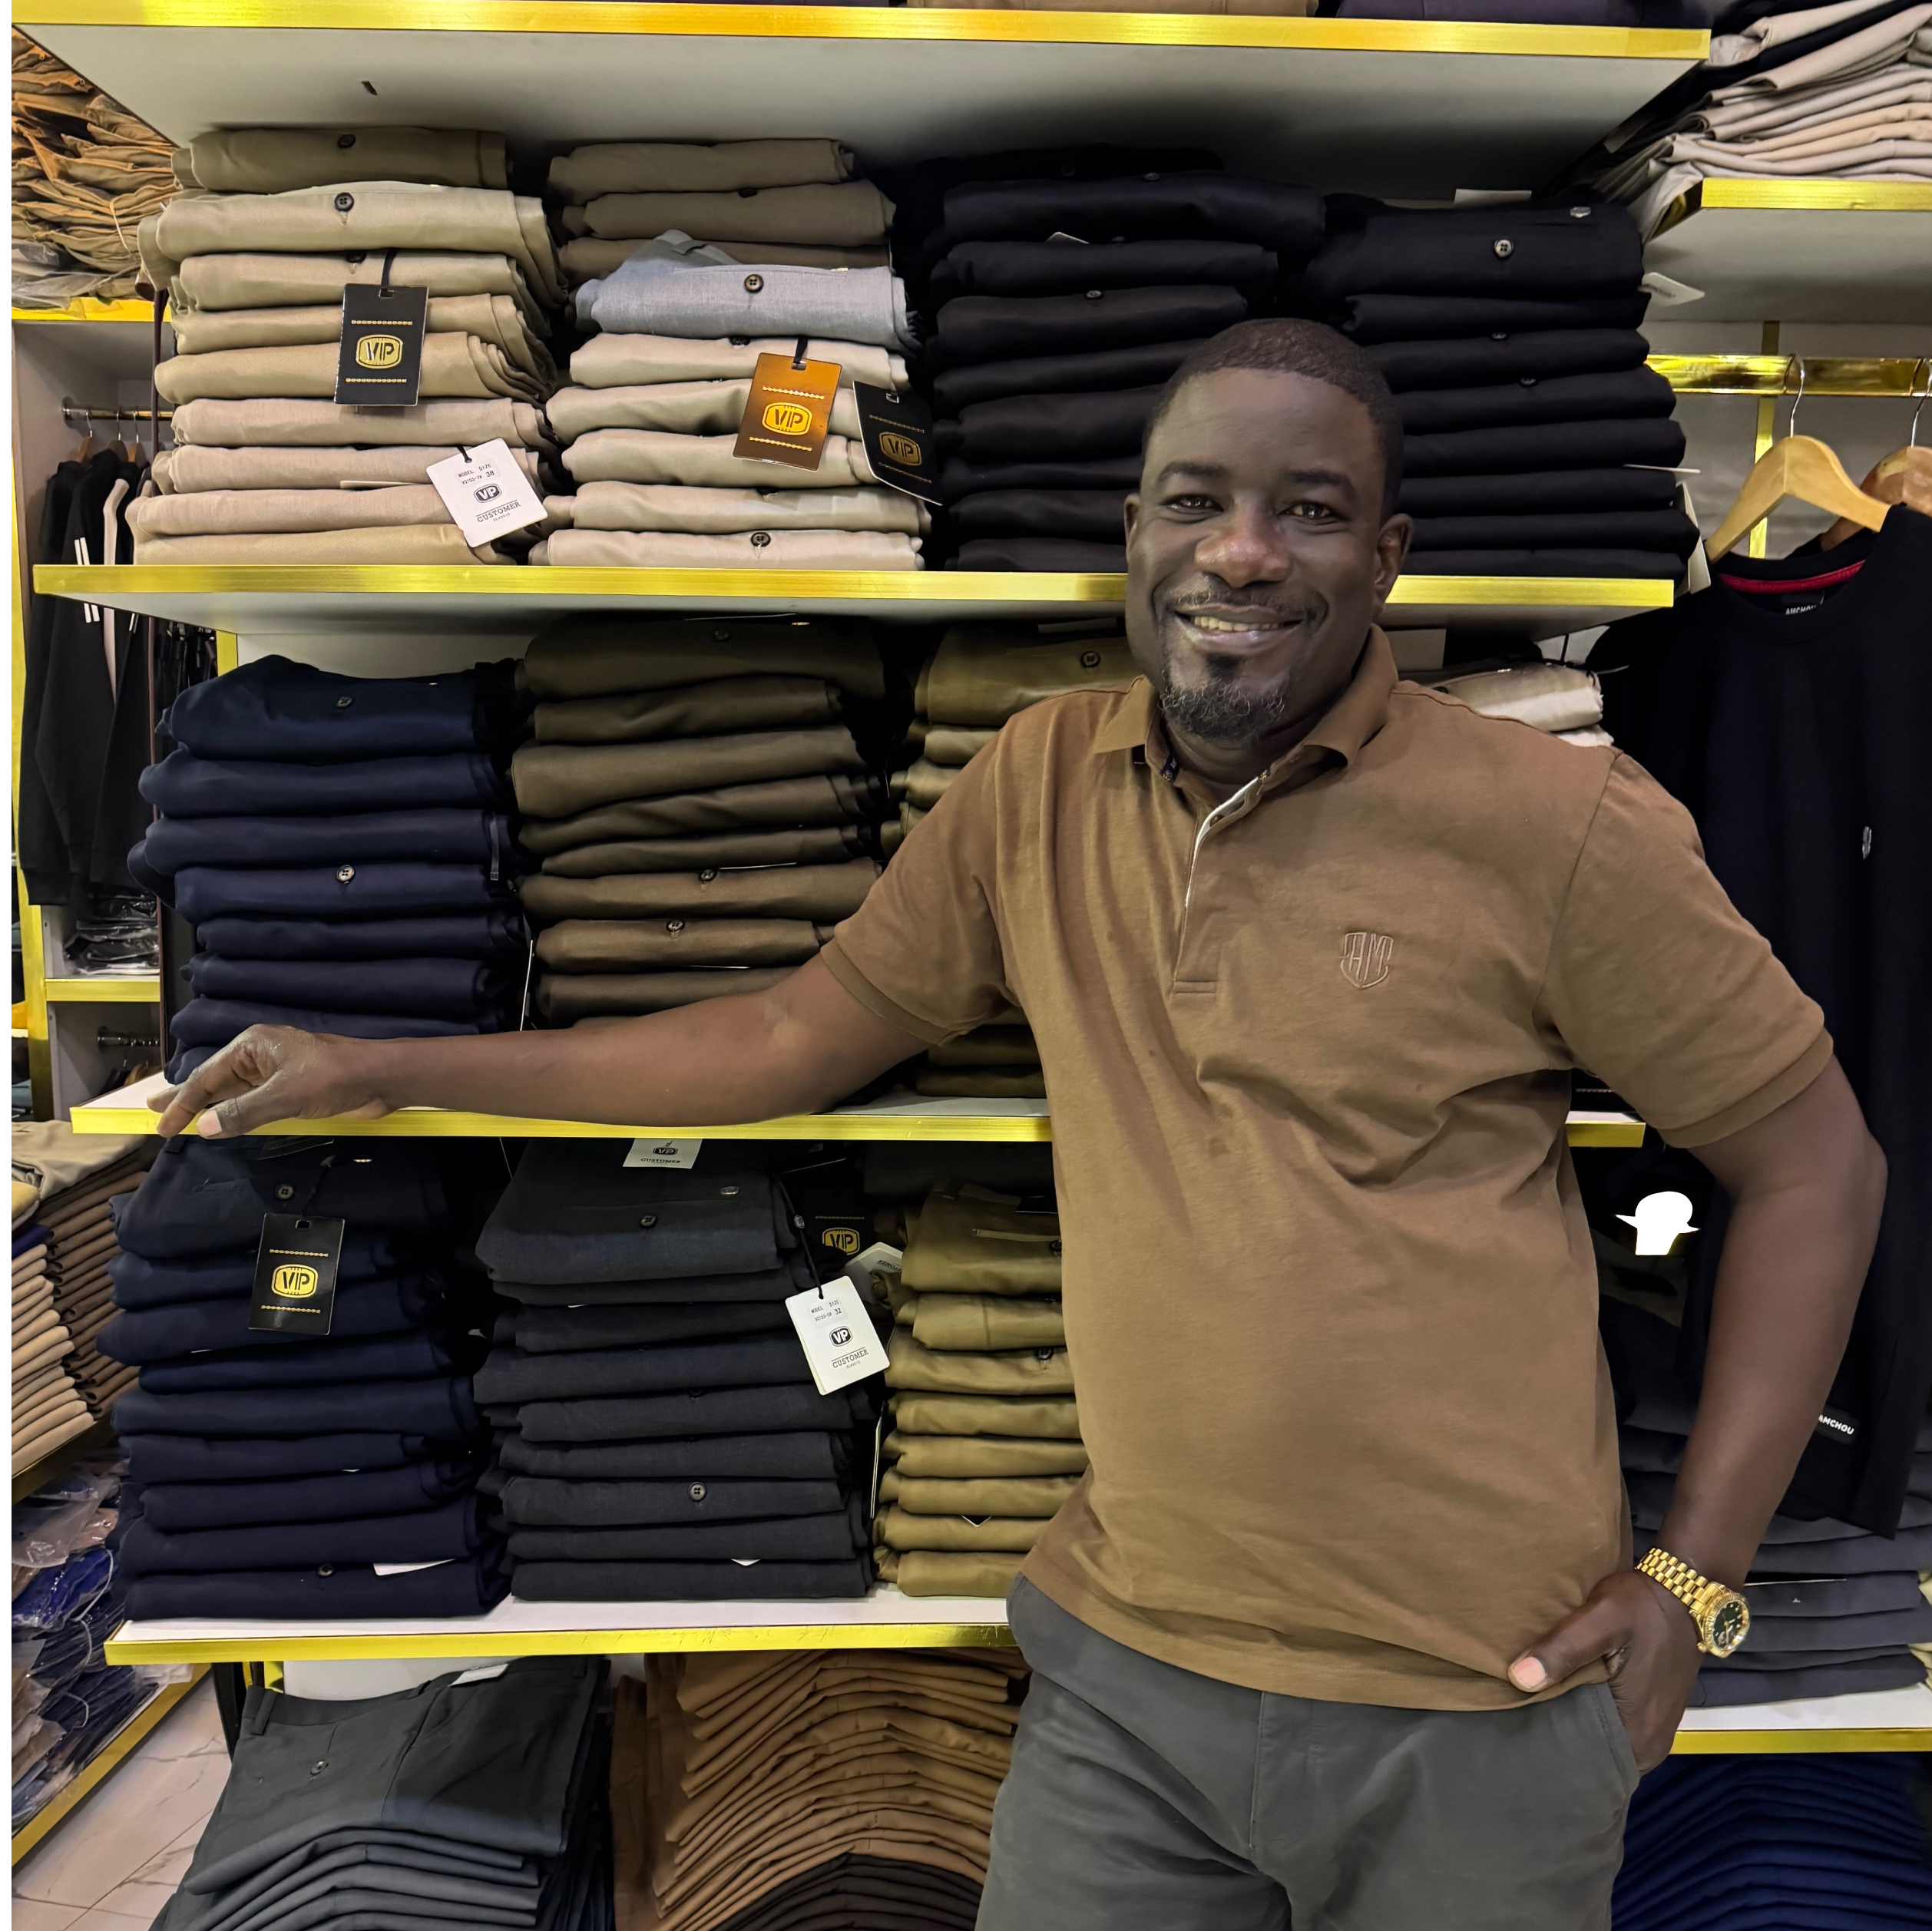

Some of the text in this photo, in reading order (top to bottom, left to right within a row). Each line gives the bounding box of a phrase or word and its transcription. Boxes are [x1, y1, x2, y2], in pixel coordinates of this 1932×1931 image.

[366, 342, 395, 361] VIP
[774, 408, 804, 428] VIP
[887, 438, 914, 458] VIP
[477, 501, 521, 523] CUSTOMER
[830, 1233, 854, 1252] VIP
[282, 1271, 310, 1291] VIP
[832, 1348, 869, 1368] CUSTOMER
[1818, 1414, 1854, 1435] AMCHOU
